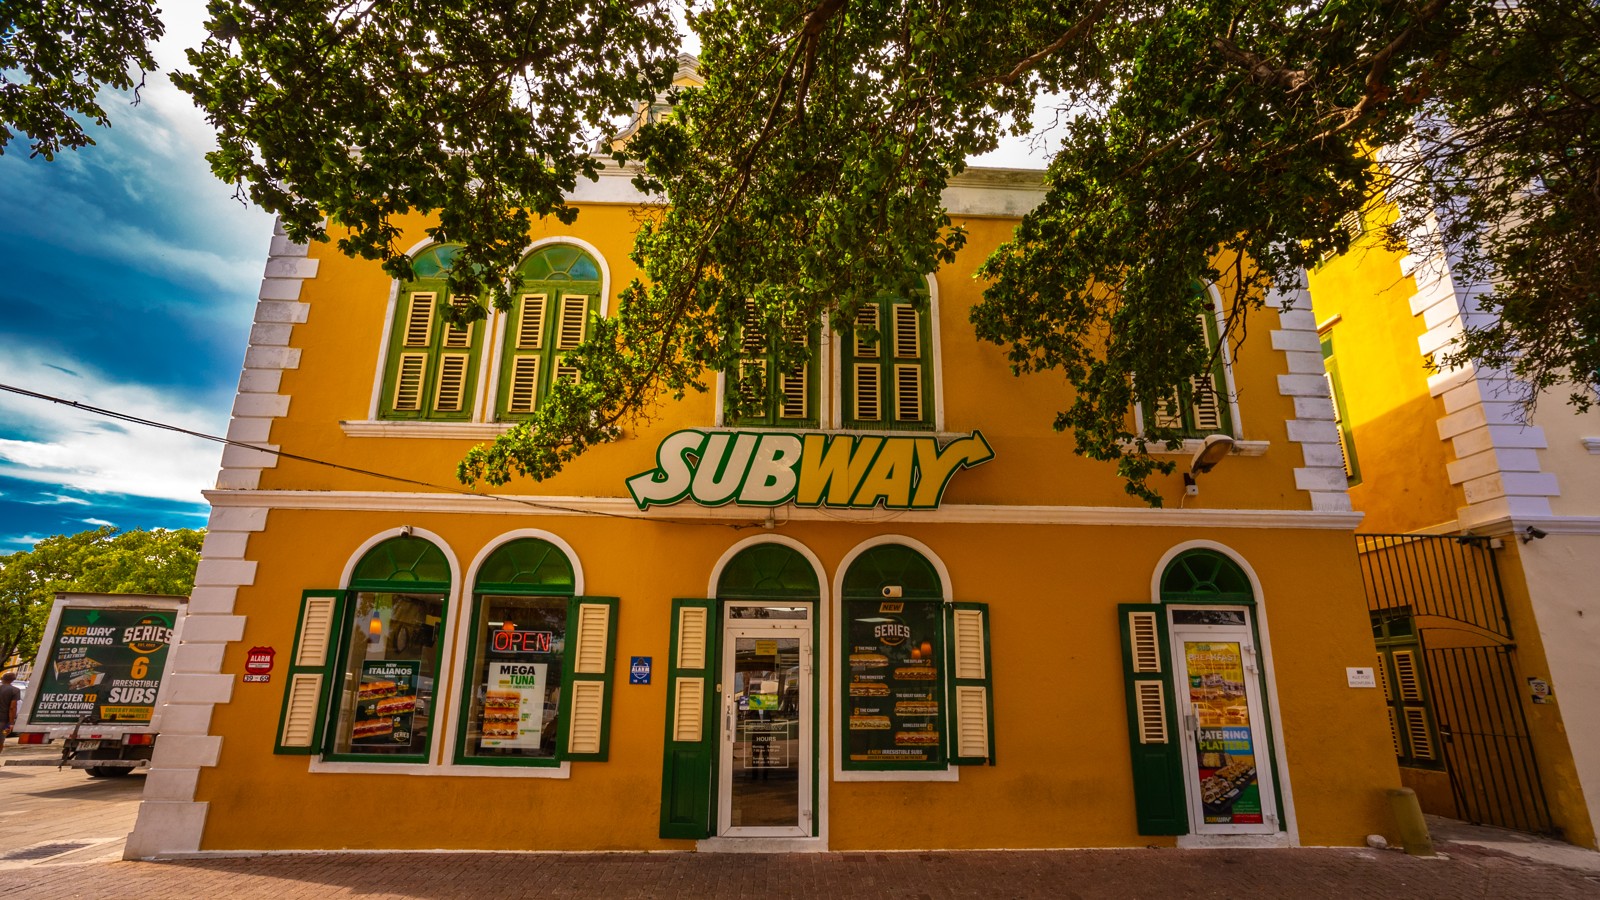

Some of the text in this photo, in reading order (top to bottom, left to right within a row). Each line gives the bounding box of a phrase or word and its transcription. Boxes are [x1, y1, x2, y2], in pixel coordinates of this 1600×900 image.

[625, 429, 995, 511] SUBWAY
[63, 626, 116, 636] SUBWAY
[122, 626, 174, 644] SERIES
[874, 624, 910, 638] SERIES
[60, 636, 114, 645] CATERING
[494, 632, 550, 652] OPEN
[1188, 653, 1238, 662] BREAKFAST
[130, 656, 150, 679] 6
[500, 666, 536, 674] MEGA
[112, 680, 159, 688] IRRESISTIBLE
[510, 675, 534, 685] TUNA
[42, 694, 97, 702] WE CATER TO
[108, 687, 156, 704] SUBS
[1200, 730, 1248, 740] CATERING
[1200, 741, 1250, 750] PLATTERS
